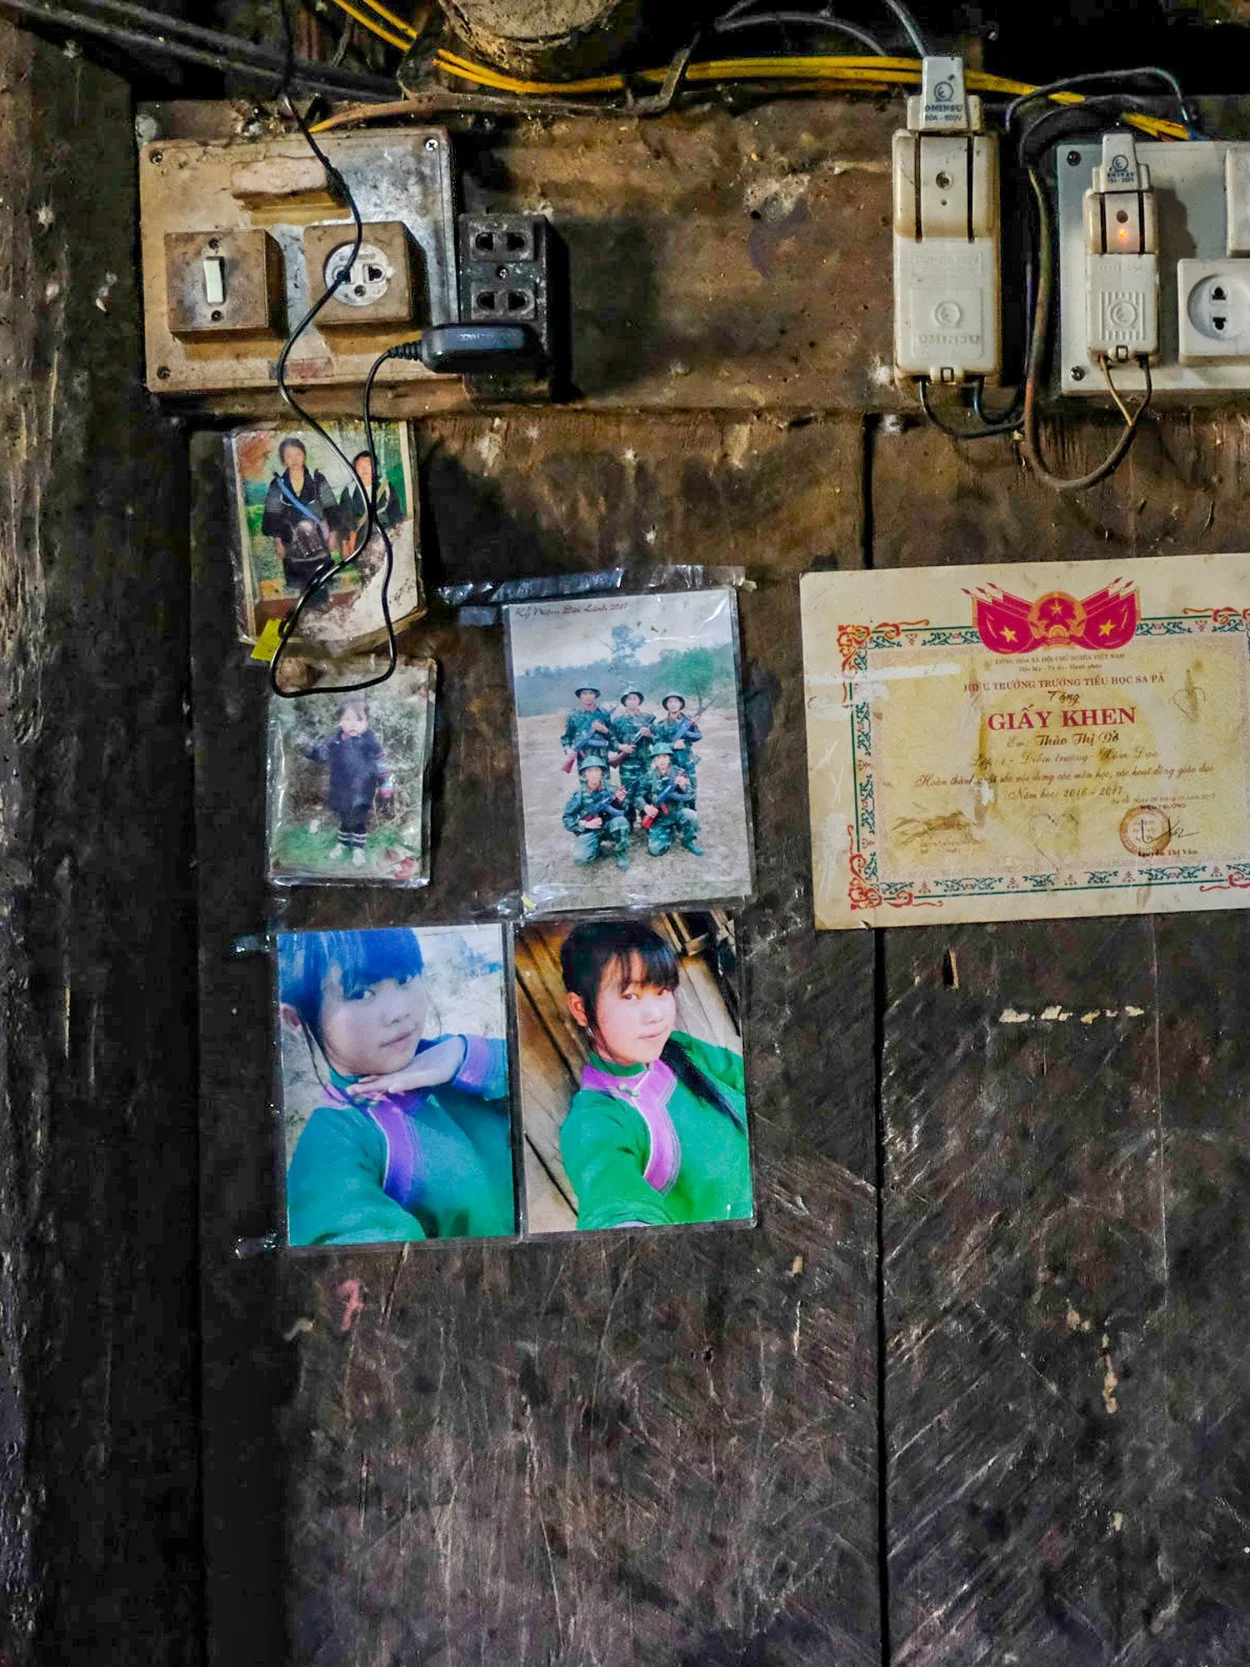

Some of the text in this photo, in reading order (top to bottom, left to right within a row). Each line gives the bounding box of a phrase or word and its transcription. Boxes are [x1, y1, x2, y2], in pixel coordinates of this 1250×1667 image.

[1136, 675, 1148, 683] SA
[988, 704, 1137, 731] GIẤY KHEN
